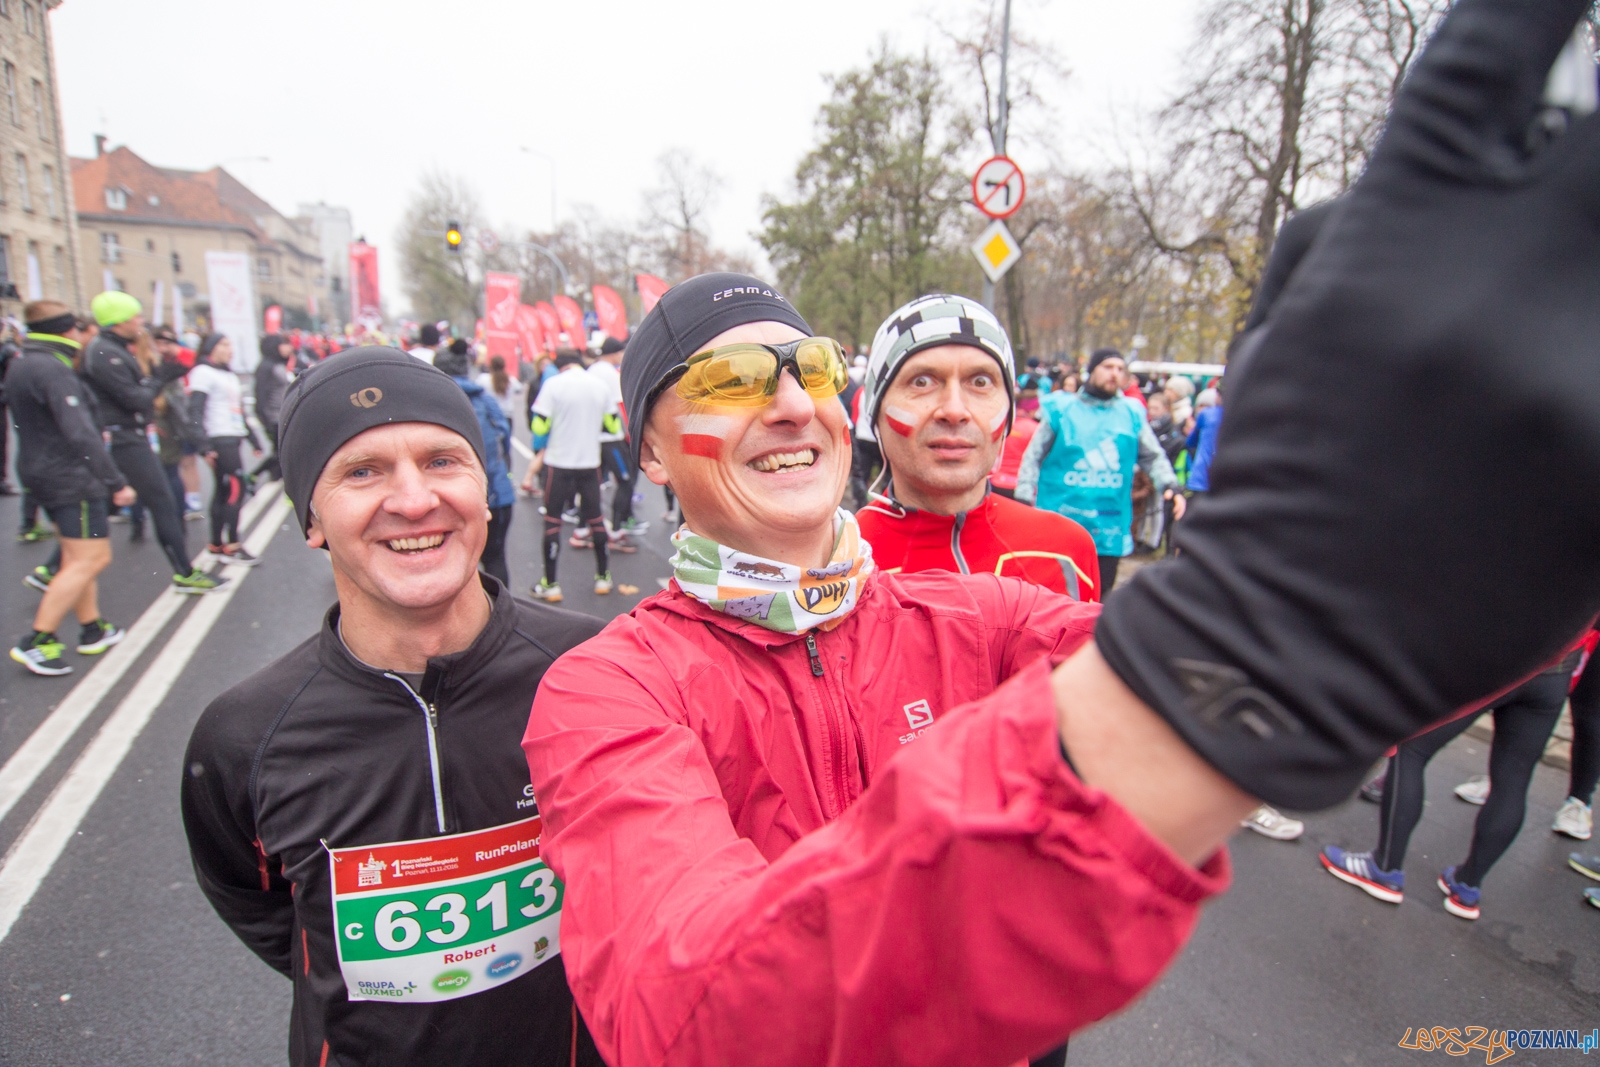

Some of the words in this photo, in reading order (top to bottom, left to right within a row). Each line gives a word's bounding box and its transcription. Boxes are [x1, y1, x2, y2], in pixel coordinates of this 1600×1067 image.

[474, 834, 542, 862] RunPoland
[374, 868, 558, 952] 6313
[443, 943, 497, 965] Robert
[358, 981, 395, 989] GRUPA
[360, 988, 403, 997] LUXMED
